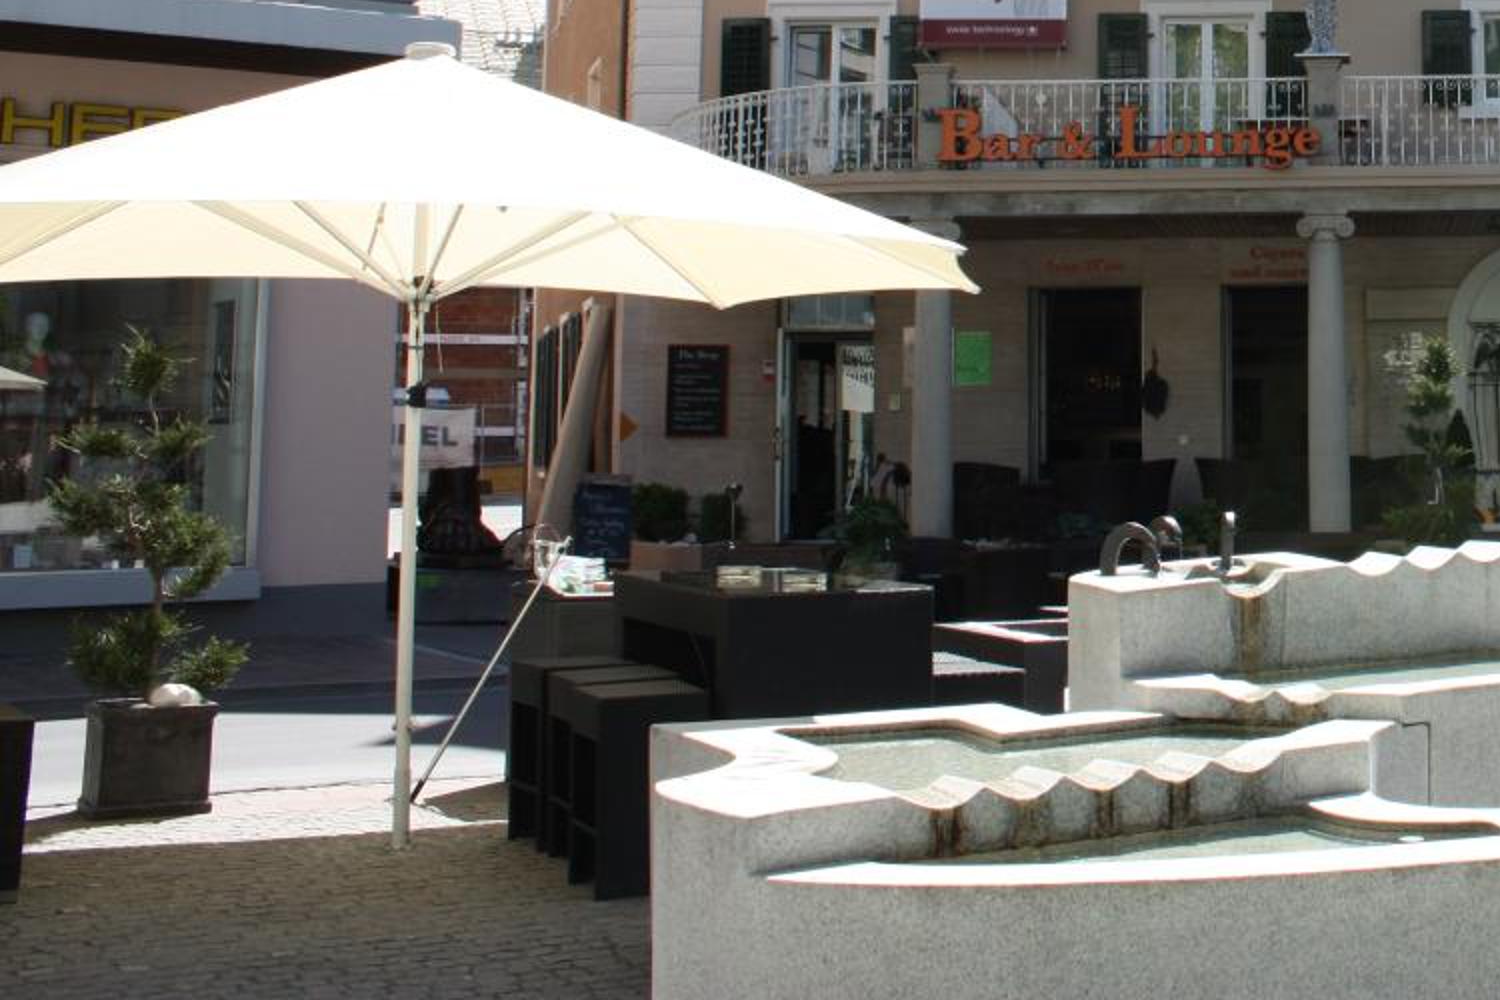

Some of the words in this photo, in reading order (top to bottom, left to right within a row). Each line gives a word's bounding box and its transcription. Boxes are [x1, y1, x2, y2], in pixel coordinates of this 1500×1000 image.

[935, 107, 1044, 161] Bar
[1060, 120, 1095, 160] &
[1113, 104, 1322, 170] Lounge
